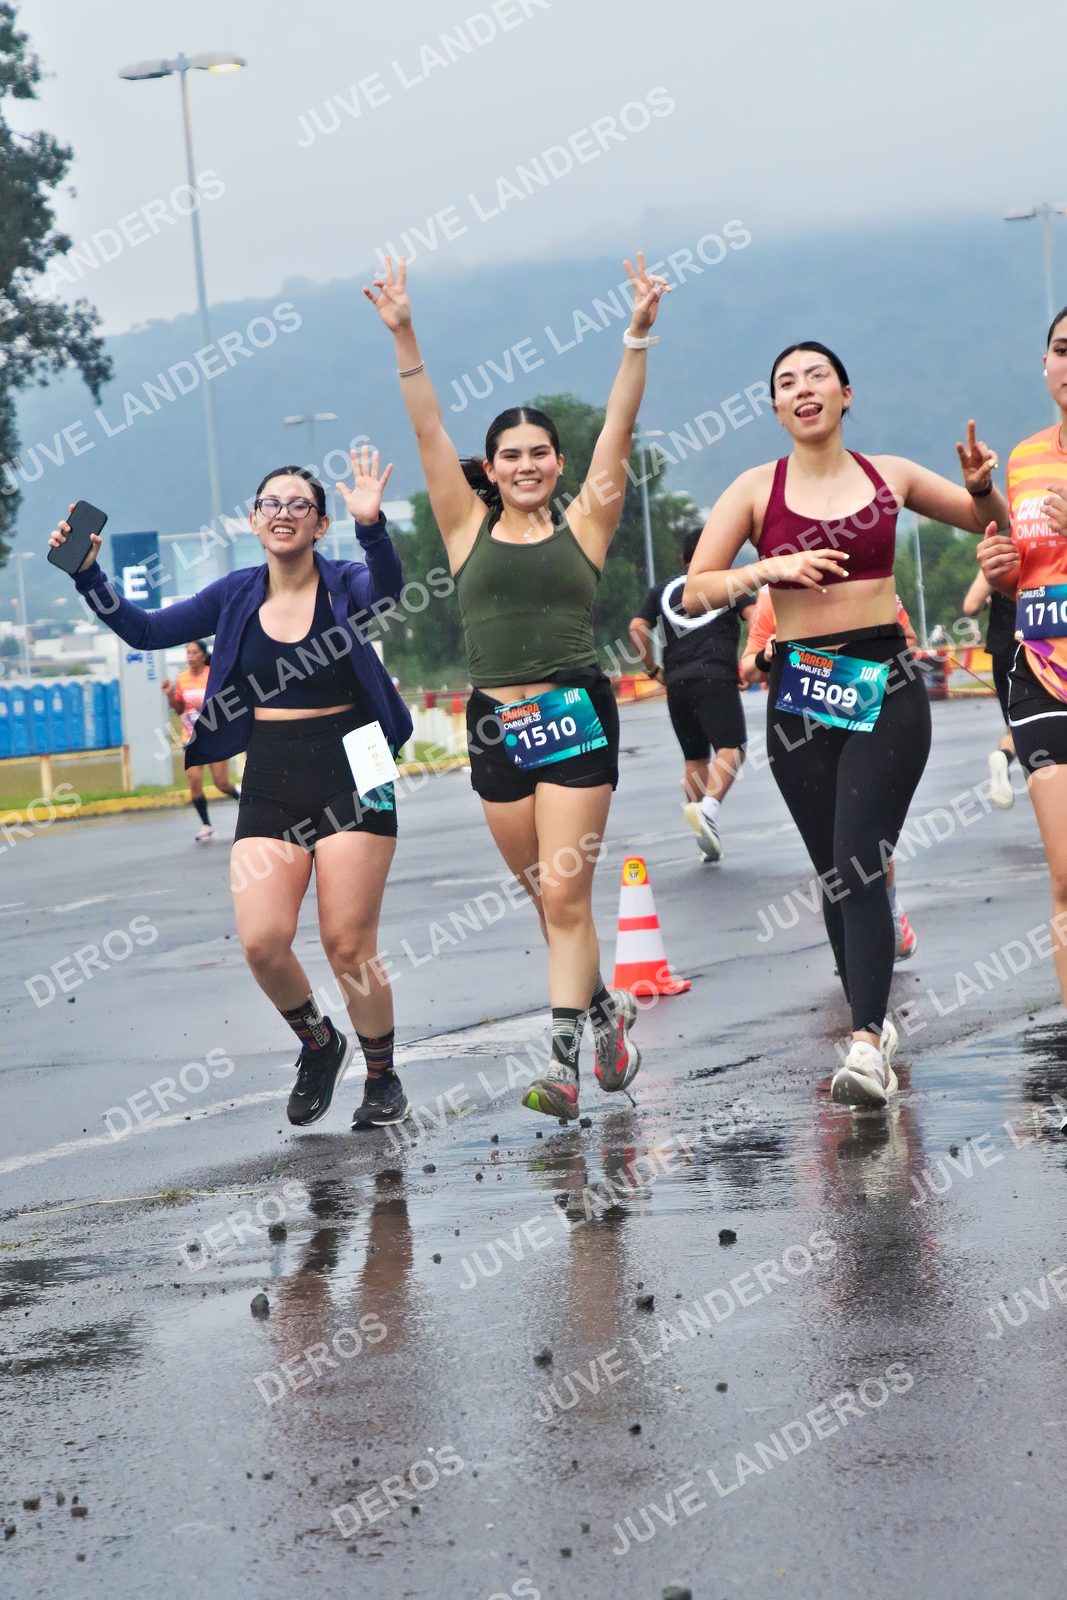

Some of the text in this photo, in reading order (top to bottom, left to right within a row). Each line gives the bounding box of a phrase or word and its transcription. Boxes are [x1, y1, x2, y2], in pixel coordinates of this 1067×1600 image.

[122, 565, 149, 600] E
[794, 650, 880, 682] ARRERA 10K
[501, 688, 582, 722] CARRERA 10K
[800, 677, 858, 708] 1509
[518, 716, 577, 749] 1510
